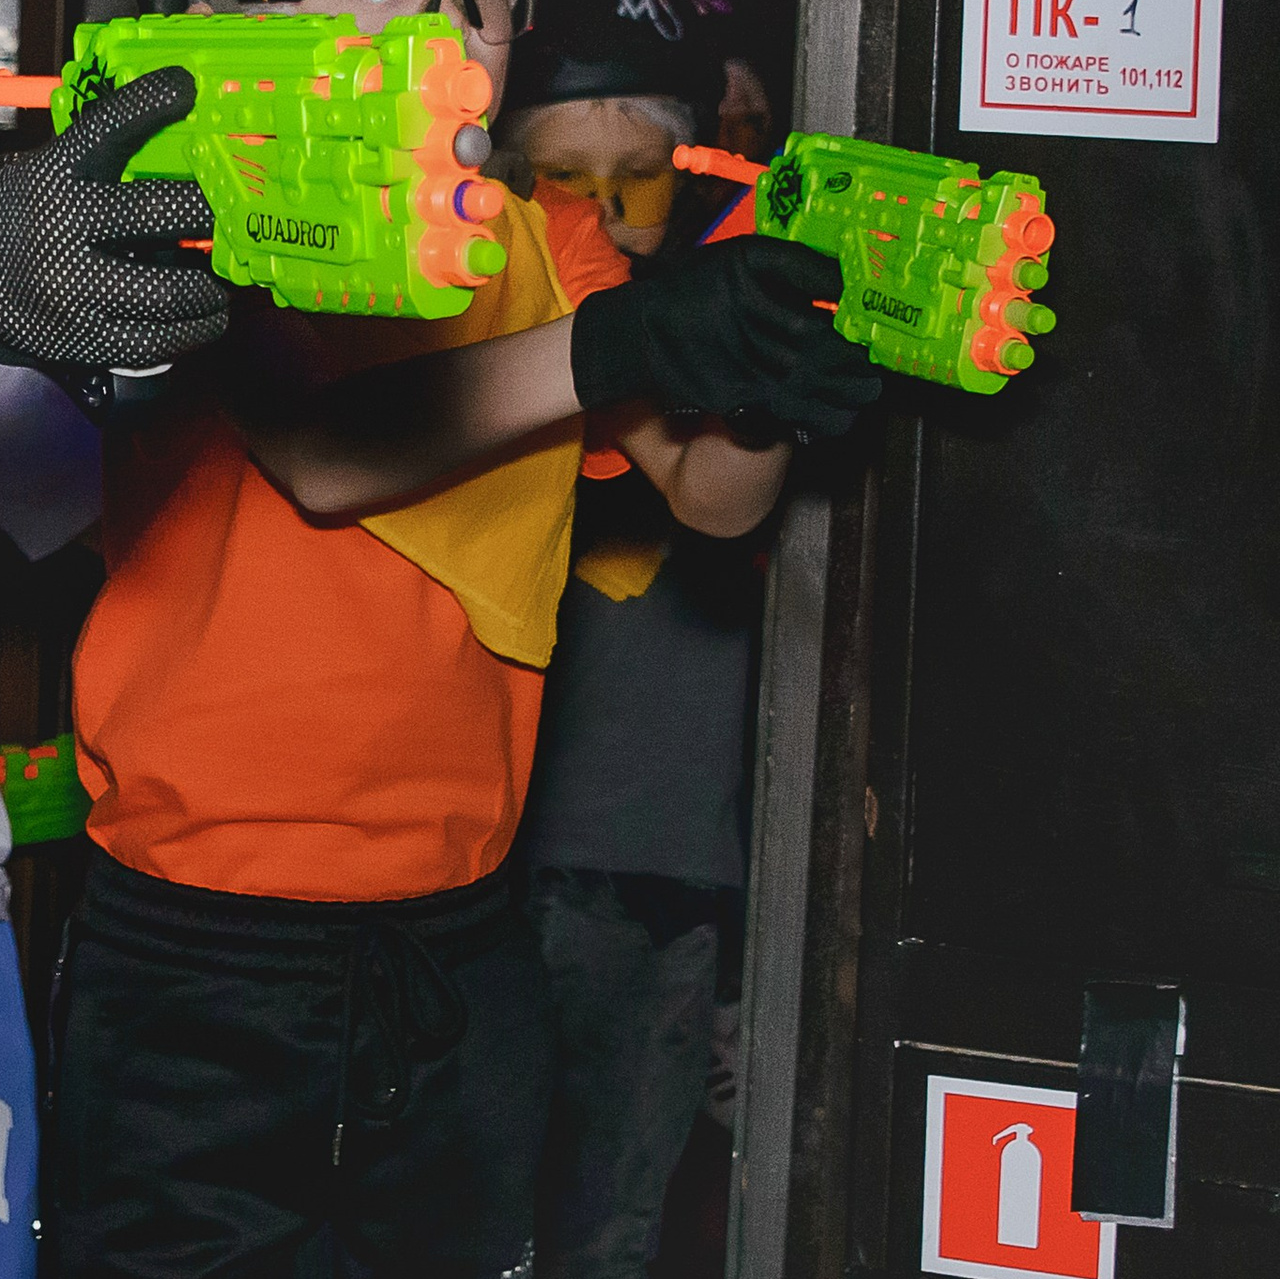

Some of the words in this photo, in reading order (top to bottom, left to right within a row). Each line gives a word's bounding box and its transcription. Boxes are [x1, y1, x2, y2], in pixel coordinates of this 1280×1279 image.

[1005, 52, 1020, 69] О
[1025, 53, 1110, 73] ПОЖАРЕ
[1004, 74, 1110, 96] ЗВОНИТЬ
[1118, 66, 1184, 90] 101,112
[245, 211, 341, 253] QUADROT
[861, 286, 924, 329] QUADROT
